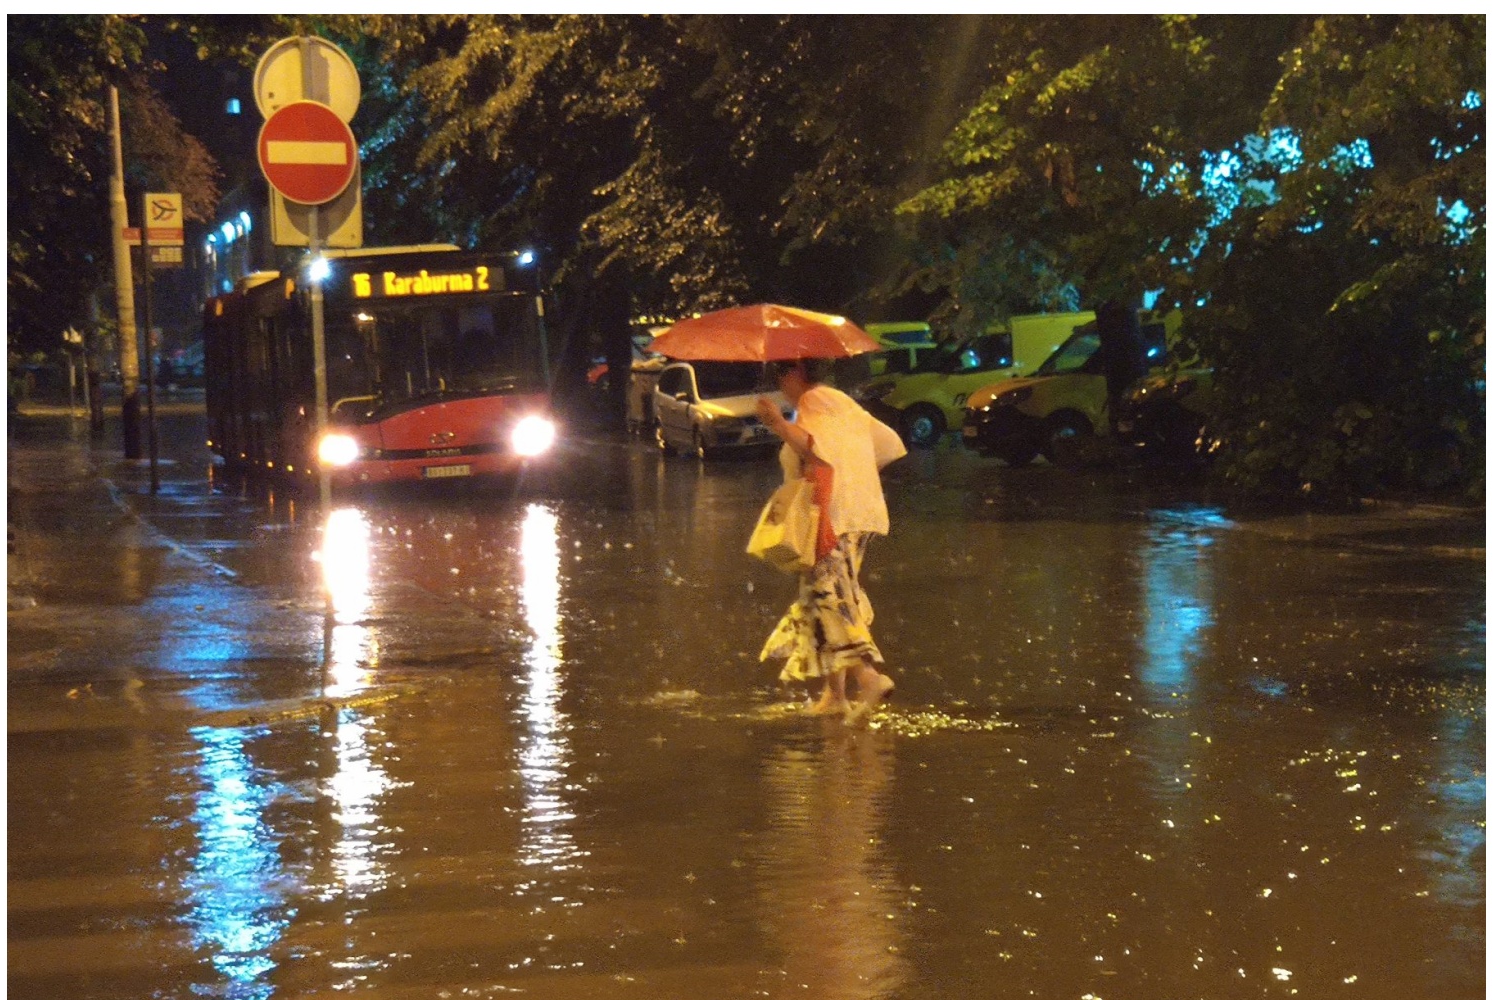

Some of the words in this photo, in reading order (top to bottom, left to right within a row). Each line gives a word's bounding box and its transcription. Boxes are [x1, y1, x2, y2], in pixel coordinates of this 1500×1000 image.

[352, 272, 372, 297] 16
[382, 269, 474, 296] Karaburma
[475, 265, 490, 291] 2
